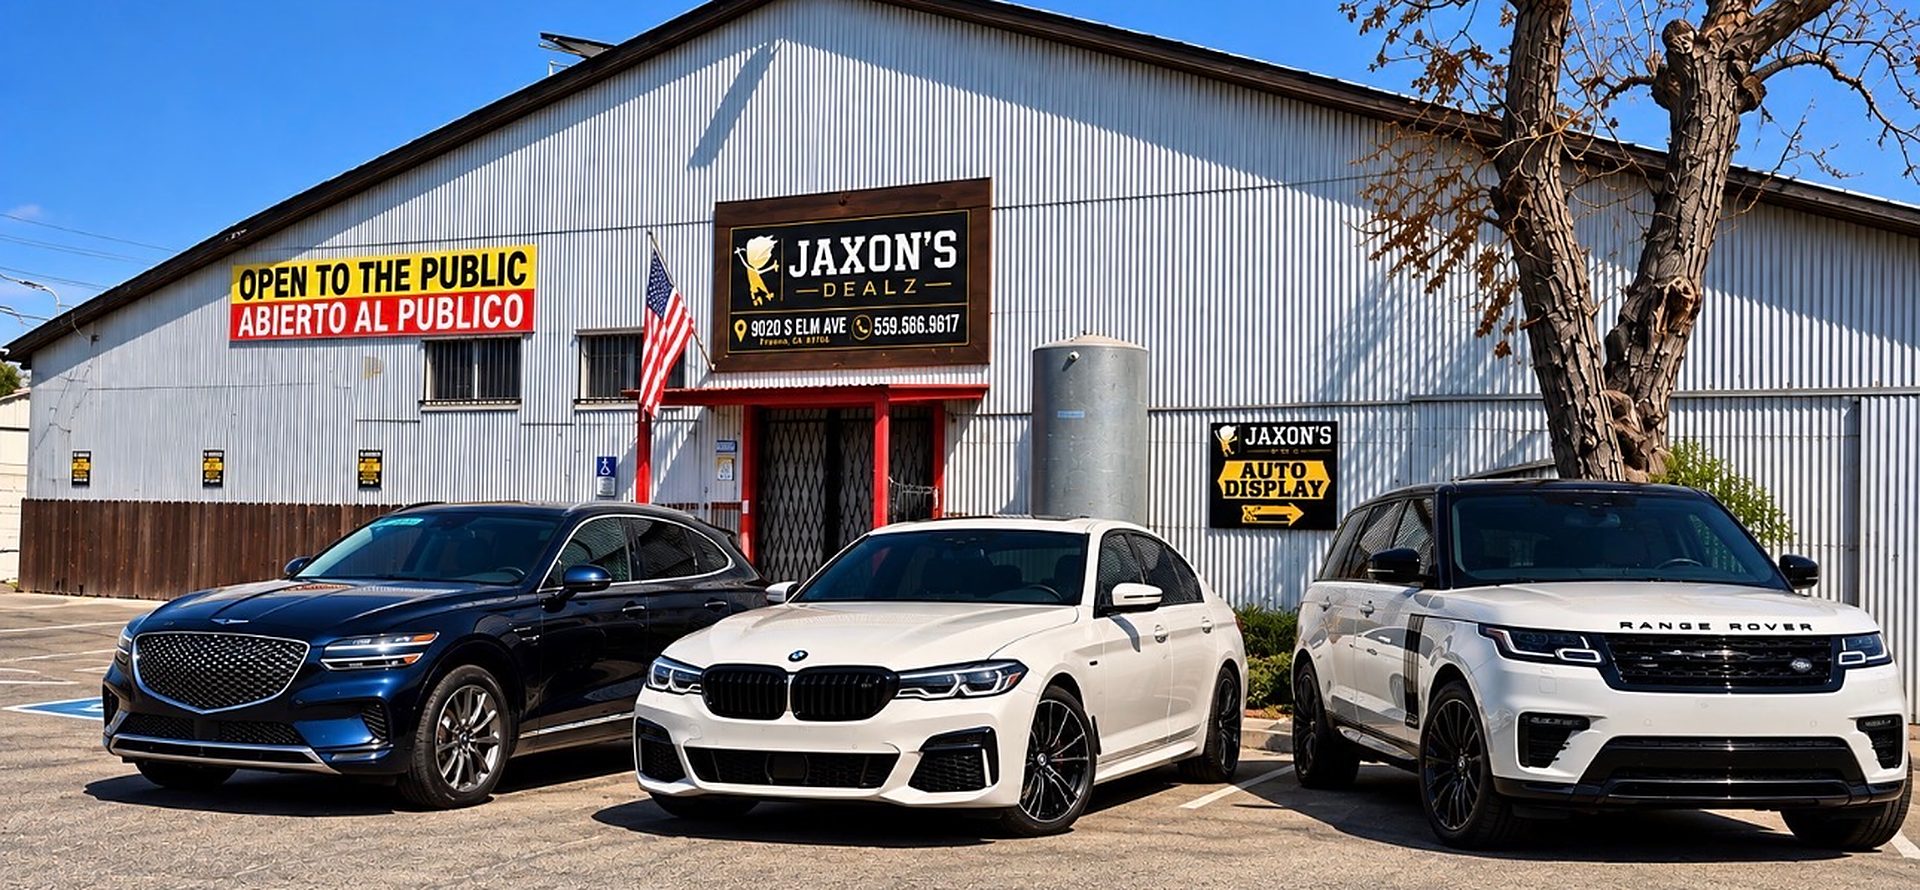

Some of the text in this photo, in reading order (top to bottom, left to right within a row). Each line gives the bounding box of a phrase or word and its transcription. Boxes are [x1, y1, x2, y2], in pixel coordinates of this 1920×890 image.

[788, 229, 957, 278] JAXON'S
[239, 250, 528, 300] OPEN TO THE PUBLIC
[823, 278, 917, 298] DEALZ
[237, 293, 524, 337] ABIERTO AL PUBLICO
[874, 313, 960, 336] 559.586.9617
[751, 316, 847, 337] 9020 S ELM AVE
[1245, 425, 1332, 446] JAXON'S
[1240, 462, 1307, 480] AUTO
[1224, 480, 1324, 497] DISPLAY
[1619, 621, 1813, 631] RANGE ROVER
